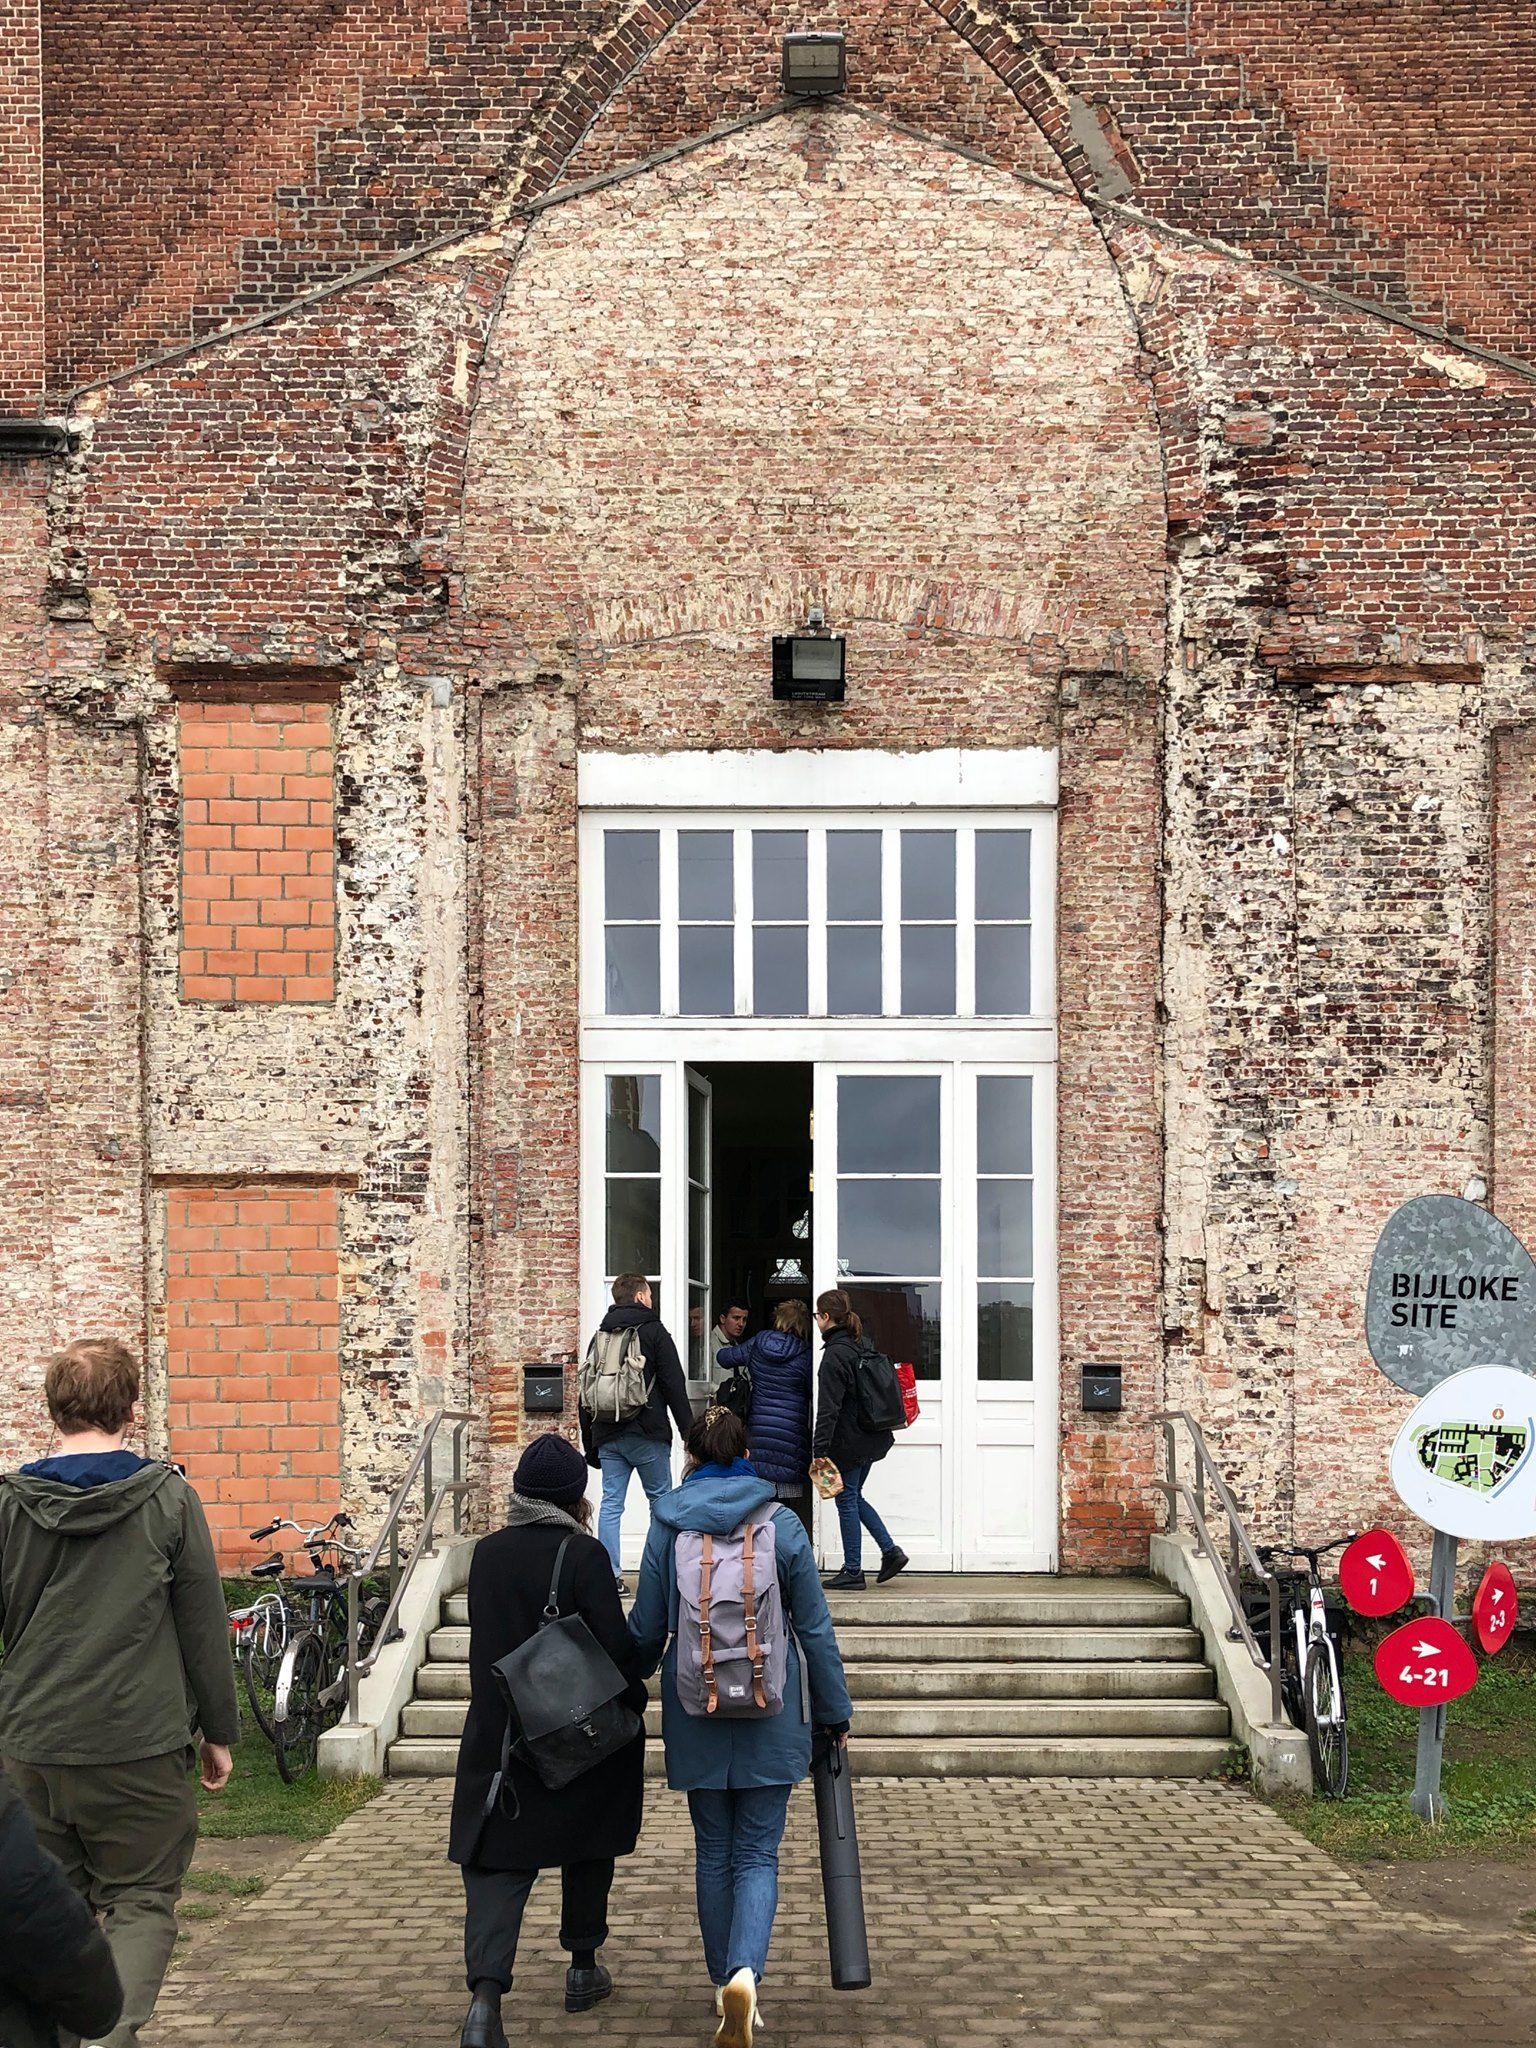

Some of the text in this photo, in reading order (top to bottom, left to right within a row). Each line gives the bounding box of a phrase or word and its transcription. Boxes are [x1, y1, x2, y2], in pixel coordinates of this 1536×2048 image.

[1392, 1273, 1519, 1301] BIJLOKE
[1390, 1303, 1458, 1329] SITE
[1369, 1578, 1378, 1596] 1
[1490, 1610, 1506, 1633] 2-3
[1399, 1665, 1449, 1687] 4-21
